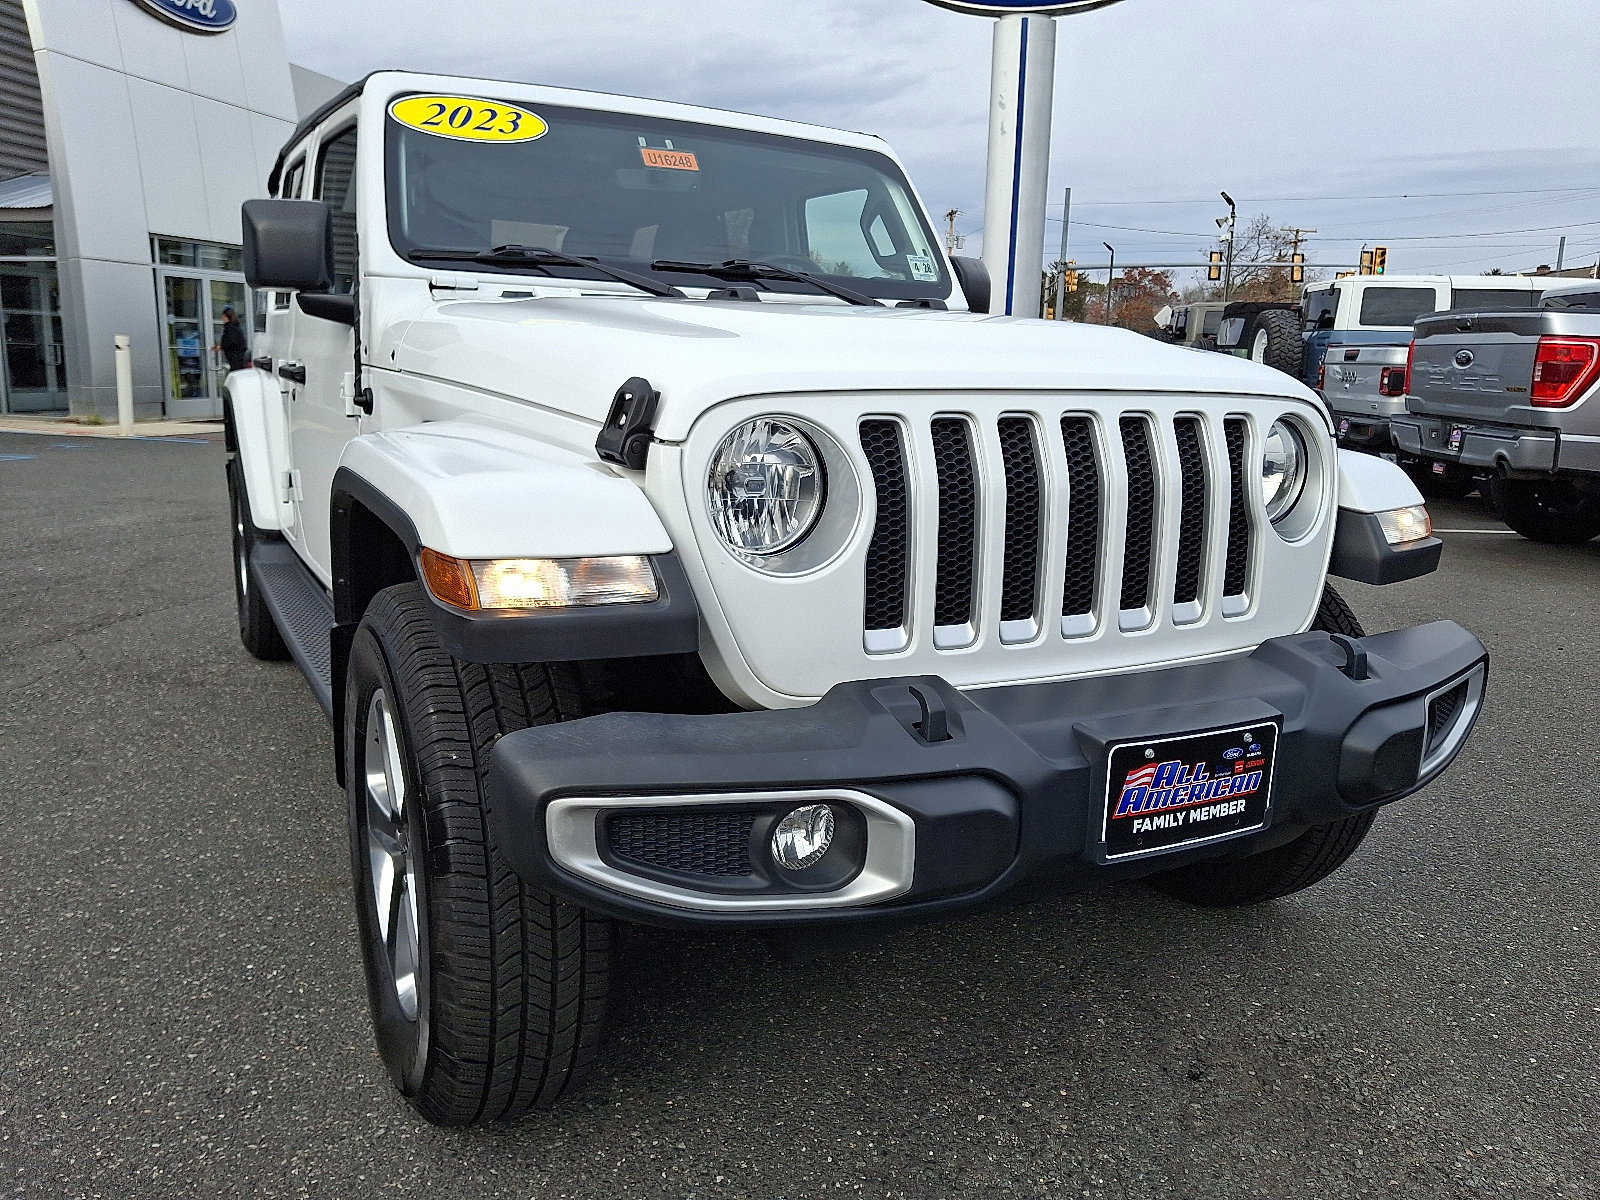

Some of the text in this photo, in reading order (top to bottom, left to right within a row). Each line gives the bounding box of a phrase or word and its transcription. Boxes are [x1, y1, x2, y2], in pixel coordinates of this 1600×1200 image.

[420, 103, 522, 135] 2023
[647, 152, 692, 168] U16248
[1132, 799, 1246, 834] FAMILY MEMBER
